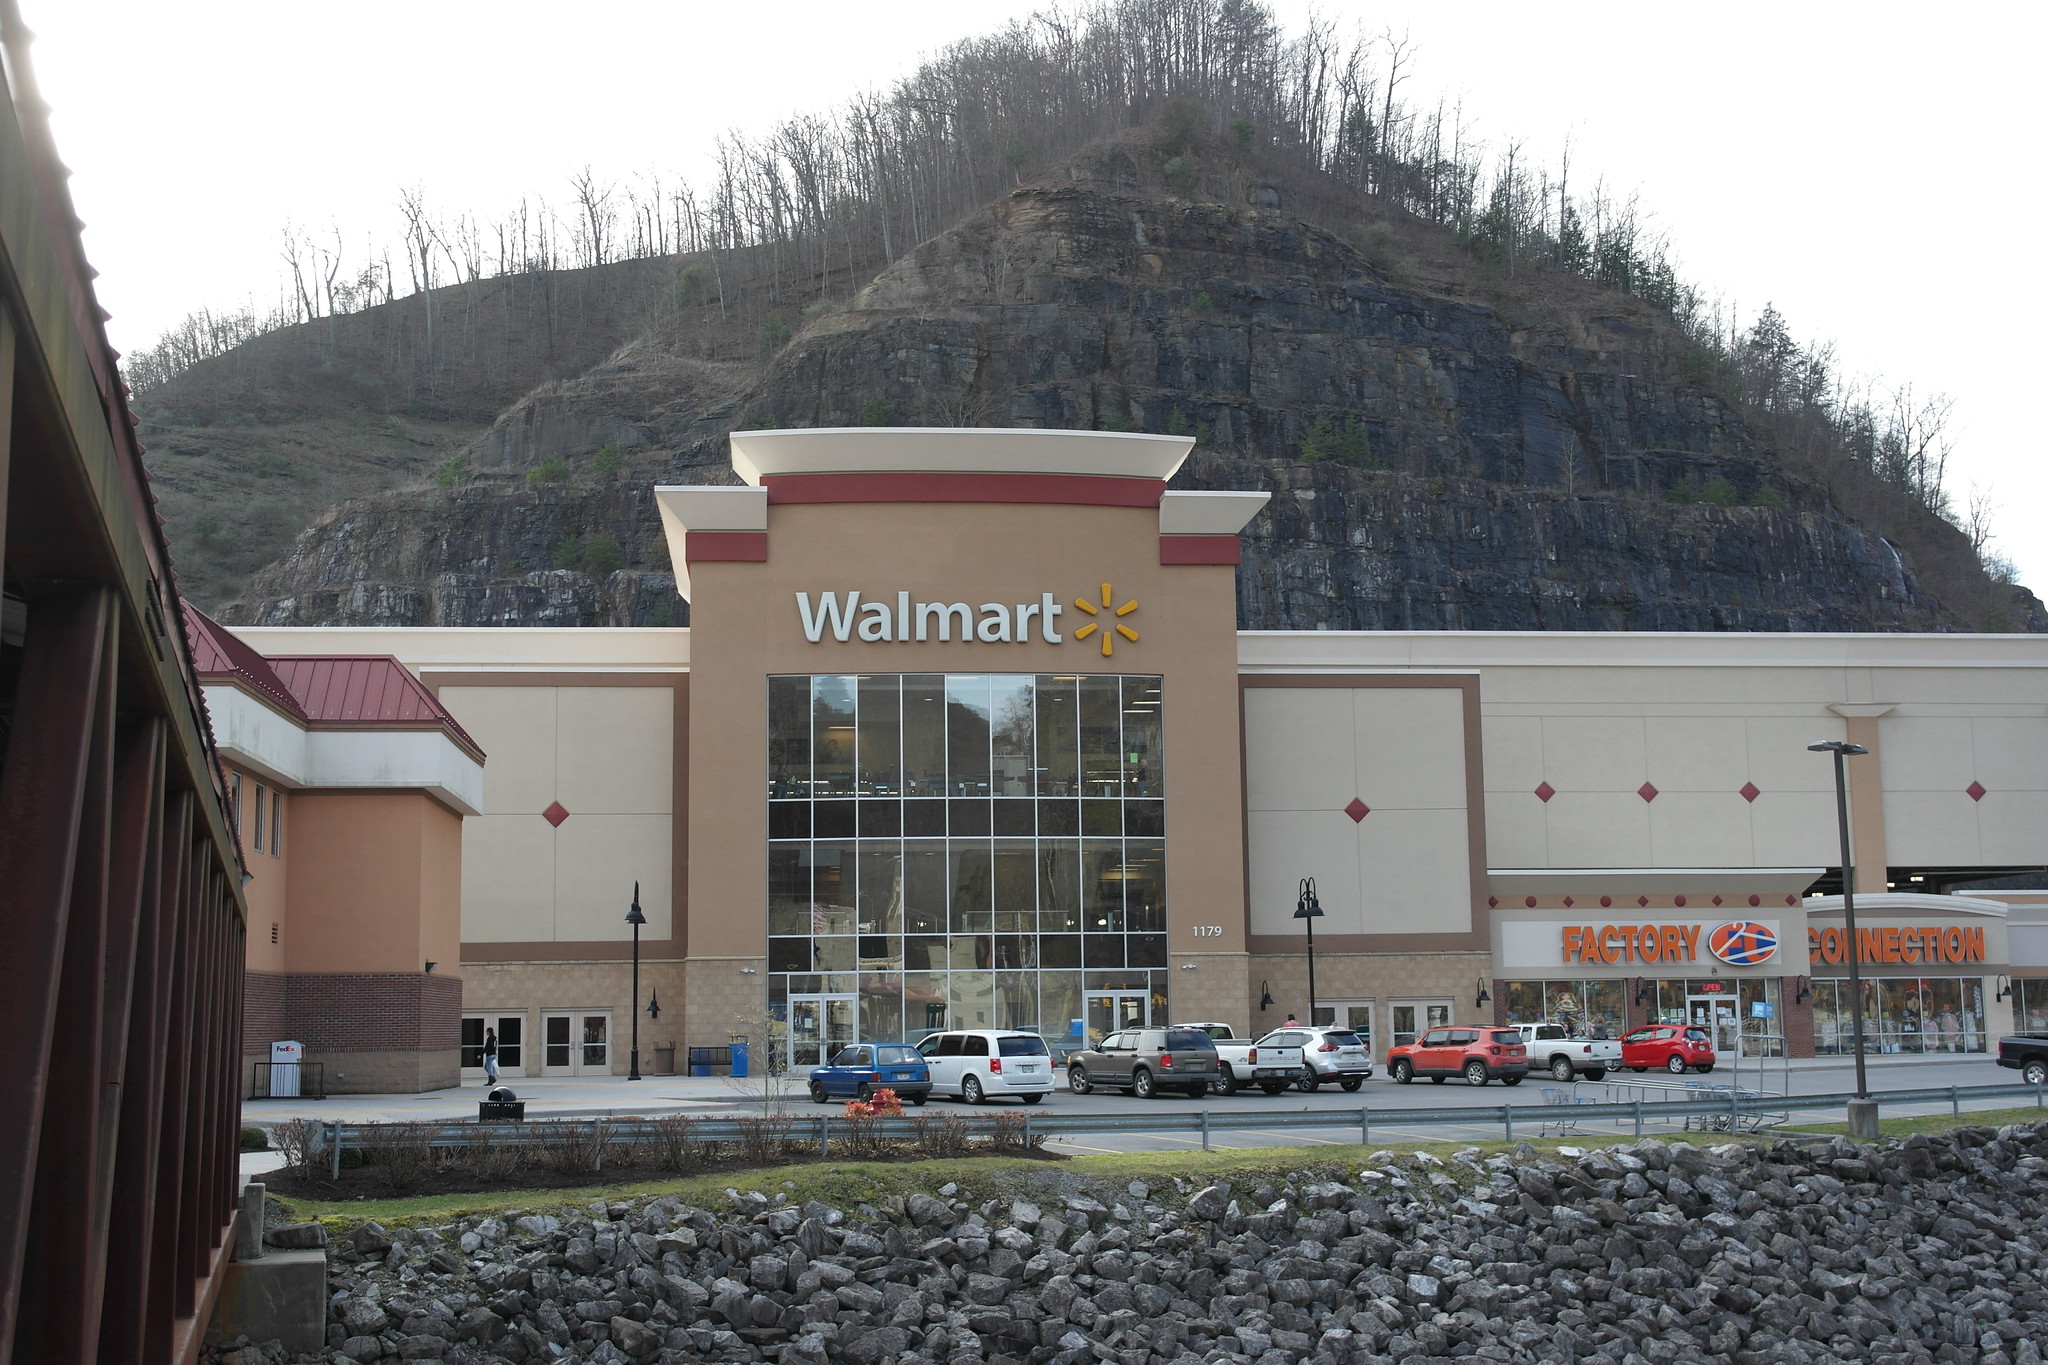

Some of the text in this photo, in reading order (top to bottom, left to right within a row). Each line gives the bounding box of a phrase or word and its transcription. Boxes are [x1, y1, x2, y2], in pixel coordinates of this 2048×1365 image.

[795, 590, 1062, 643] Walmart
[1192, 925, 1222, 937] 1179
[1562, 924, 1702, 963] FACTORY
[1702, 983, 1721, 991] OPEN
